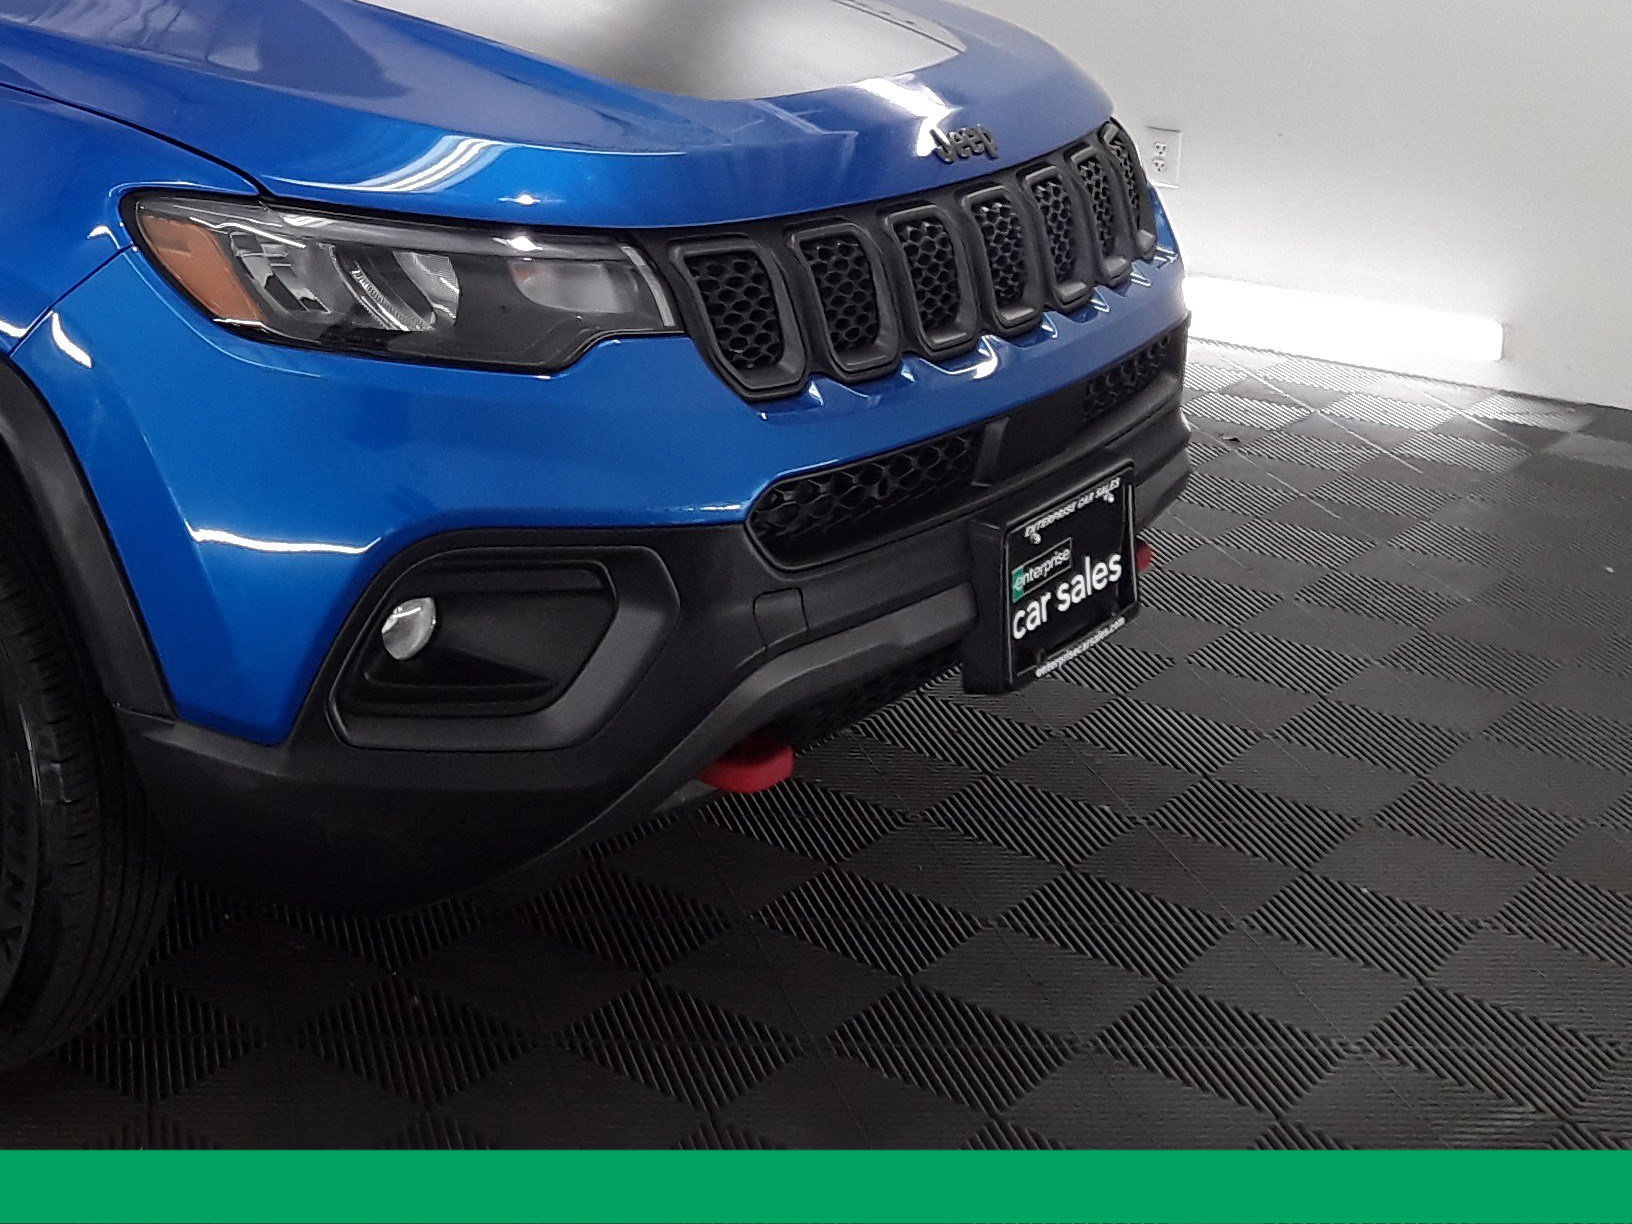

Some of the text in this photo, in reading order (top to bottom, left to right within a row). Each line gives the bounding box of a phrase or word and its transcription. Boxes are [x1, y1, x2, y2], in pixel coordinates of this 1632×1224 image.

[929, 124, 999, 164] Jeep
[1012, 547, 1071, 590] enterprise
[1012, 553, 1122, 640] car sales
